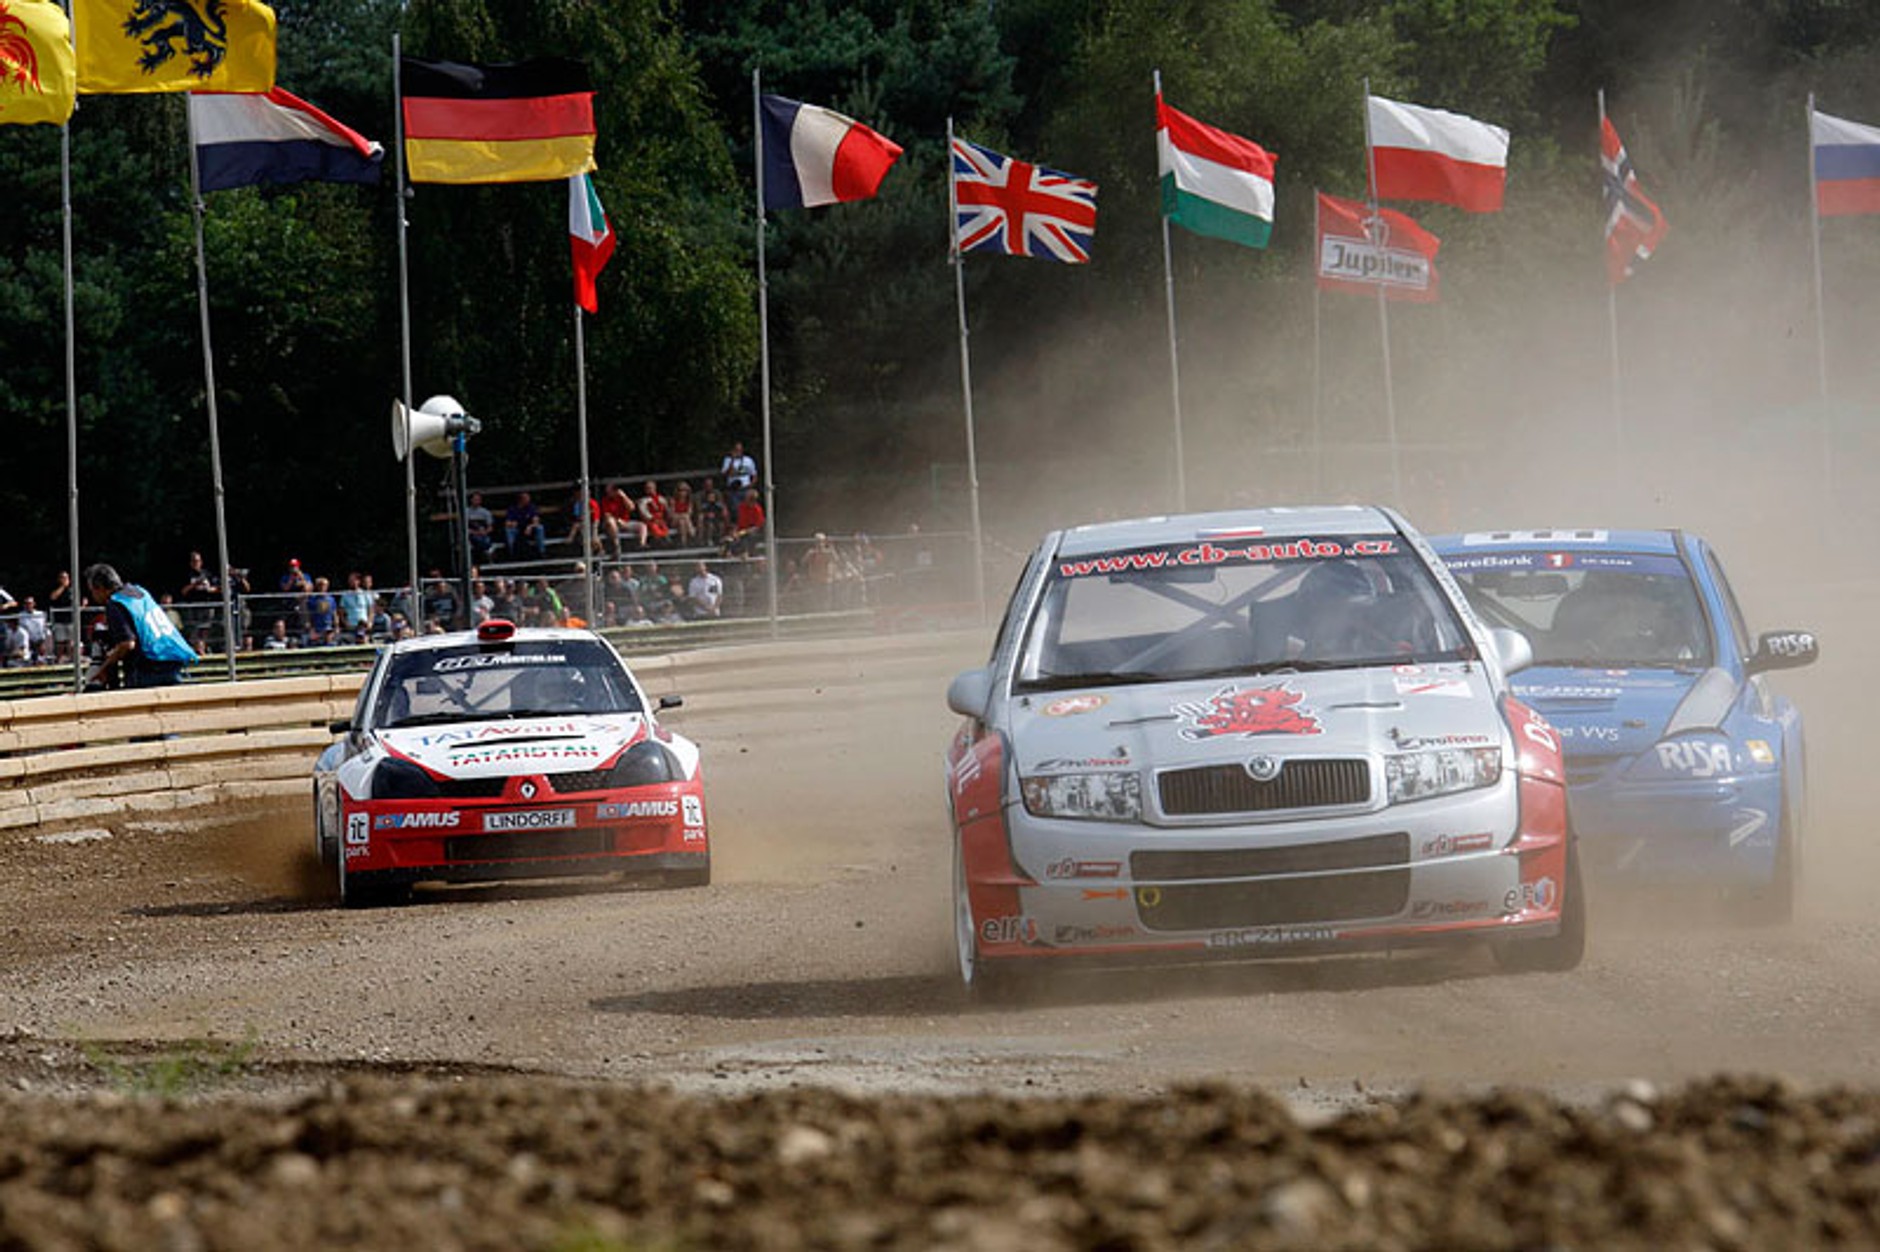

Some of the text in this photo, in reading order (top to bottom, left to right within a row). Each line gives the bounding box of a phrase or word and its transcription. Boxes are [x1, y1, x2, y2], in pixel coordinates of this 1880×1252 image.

[1060, 539, 1399, 578] www.cb-auto.cz
[1446, 554, 1533, 570] pareBank
[1767, 633, 1814, 657] RISA
[1655, 741, 1734, 777] RISA
[489, 812, 569, 829] LINDORFF
[982, 915, 1021, 942] elf
